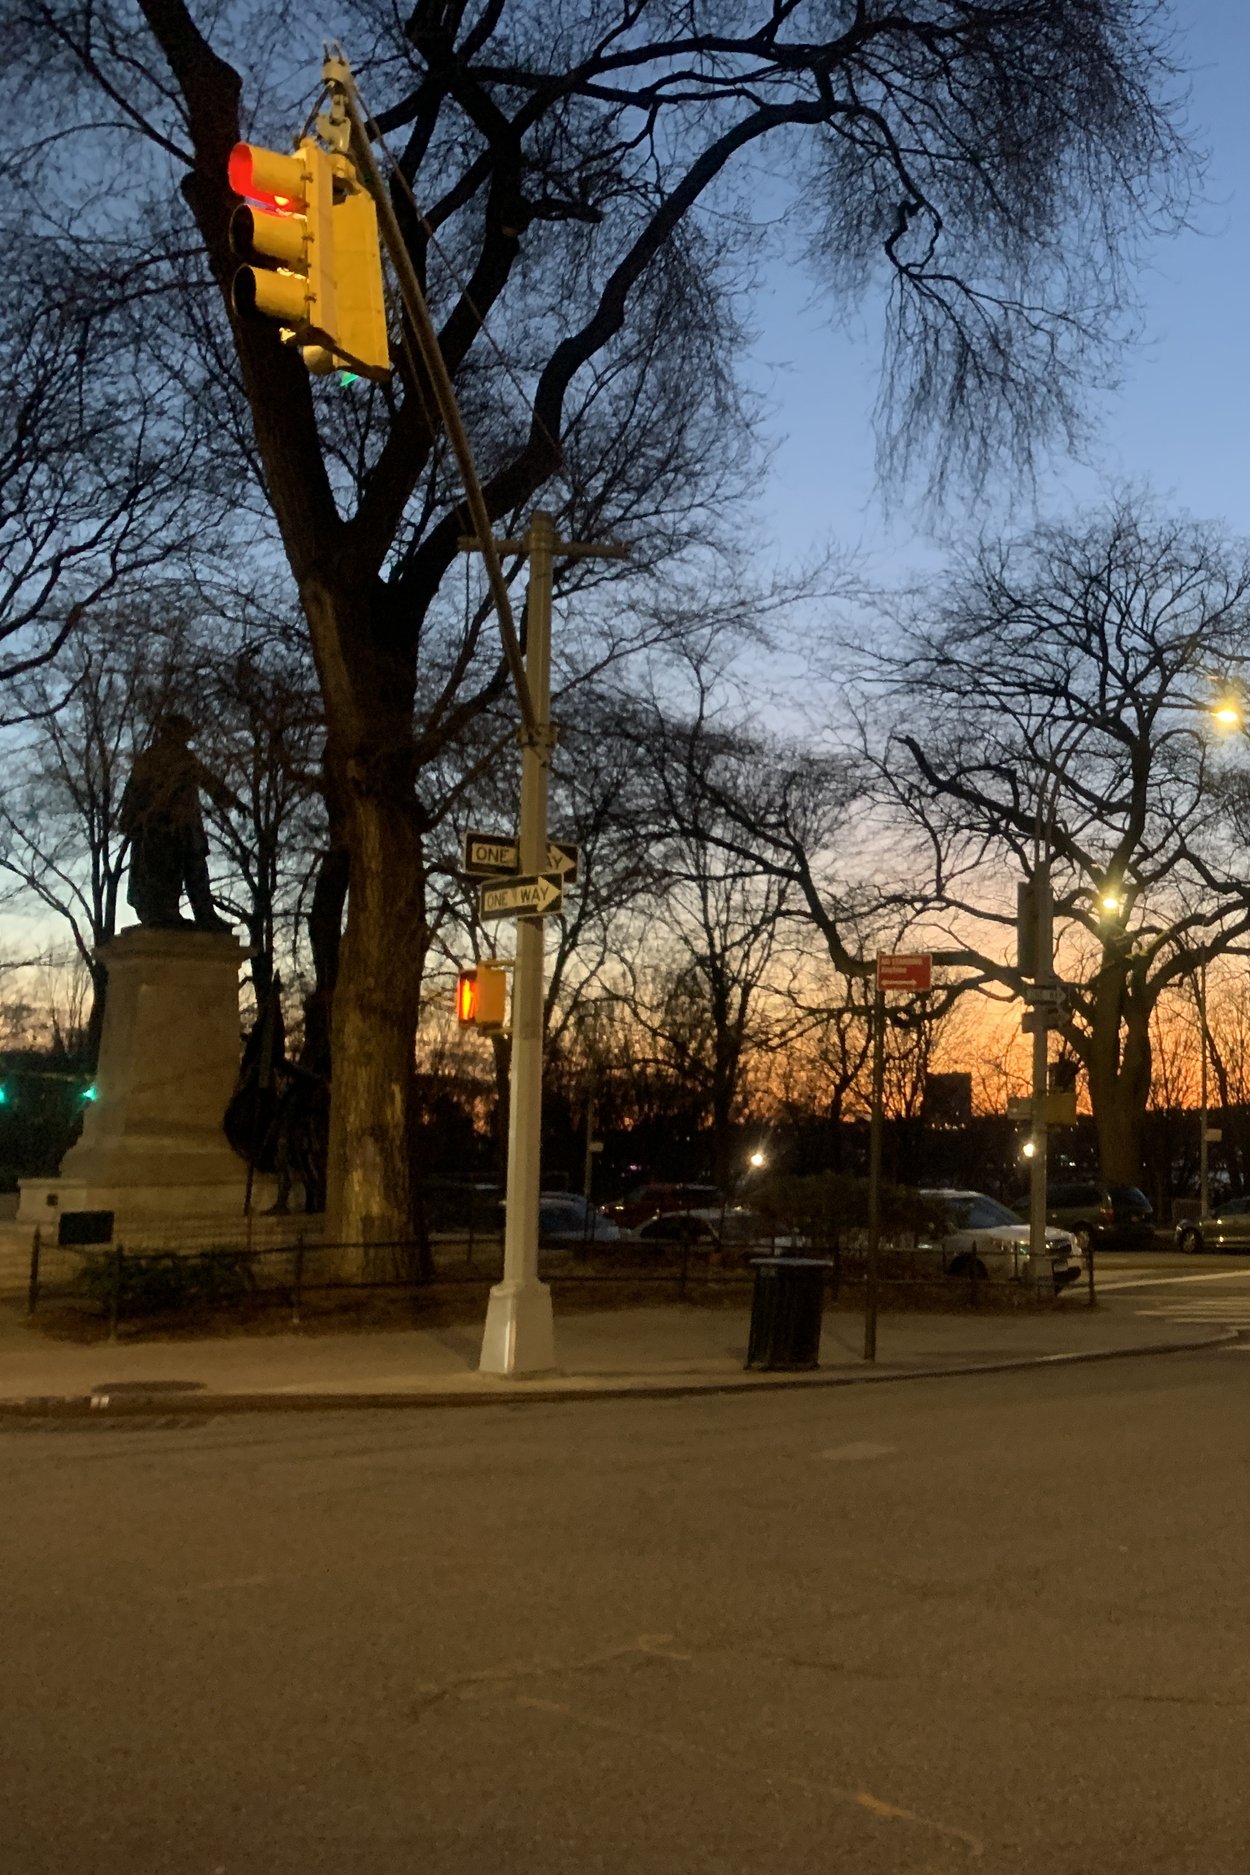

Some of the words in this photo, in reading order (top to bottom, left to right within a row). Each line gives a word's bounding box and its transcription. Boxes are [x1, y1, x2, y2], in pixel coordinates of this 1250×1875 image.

[475, 845, 510, 864] ONE
[487, 891, 509, 908] ONE
[520, 886, 550, 904] WAY
